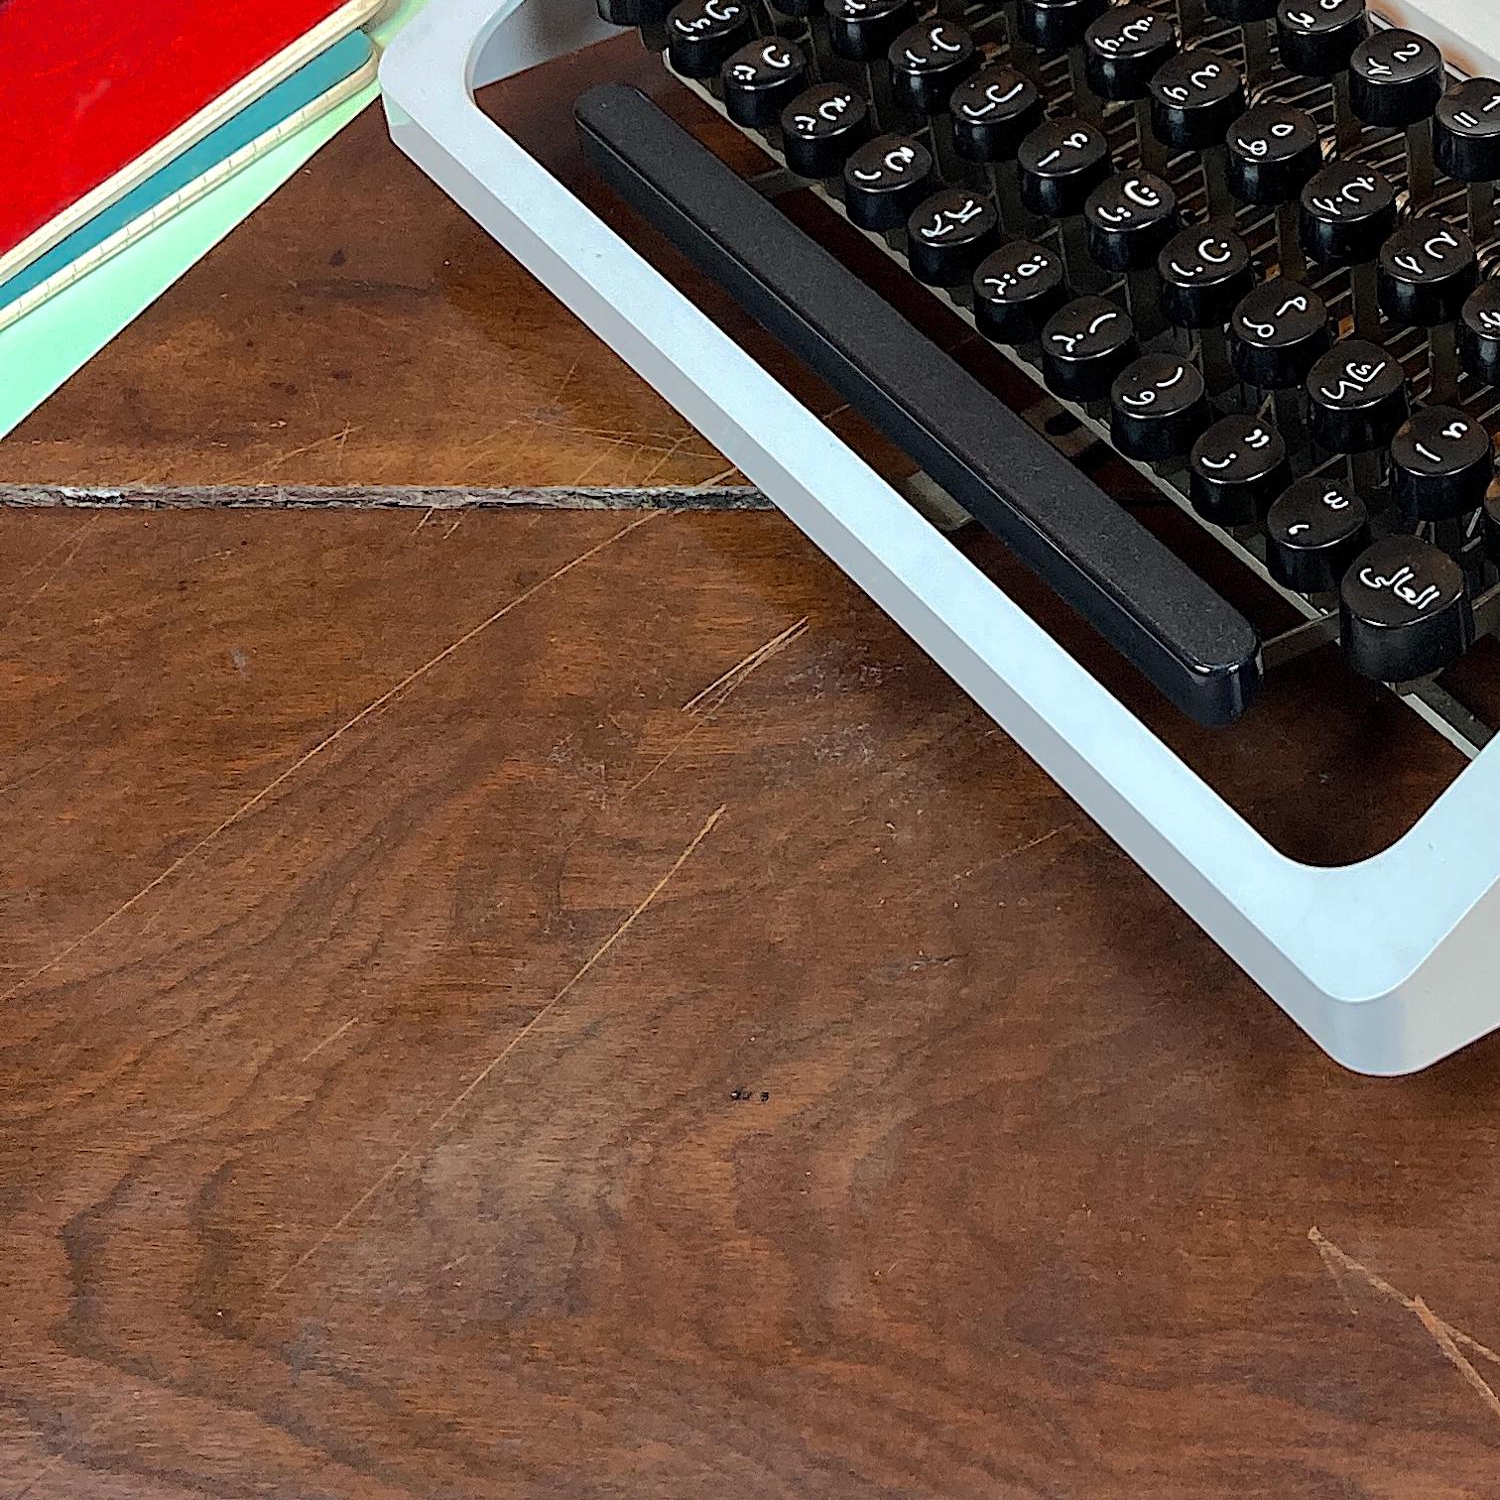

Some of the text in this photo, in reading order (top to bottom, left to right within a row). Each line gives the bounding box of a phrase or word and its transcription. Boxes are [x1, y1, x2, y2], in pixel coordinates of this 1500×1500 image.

[1393, 43, 1421, 62] 2
[985, 83, 1024, 103] ل
[1341, 177, 1375, 203] خ
[1424, 231, 1458, 259] ح
[1276, 296, 1307, 317] م
